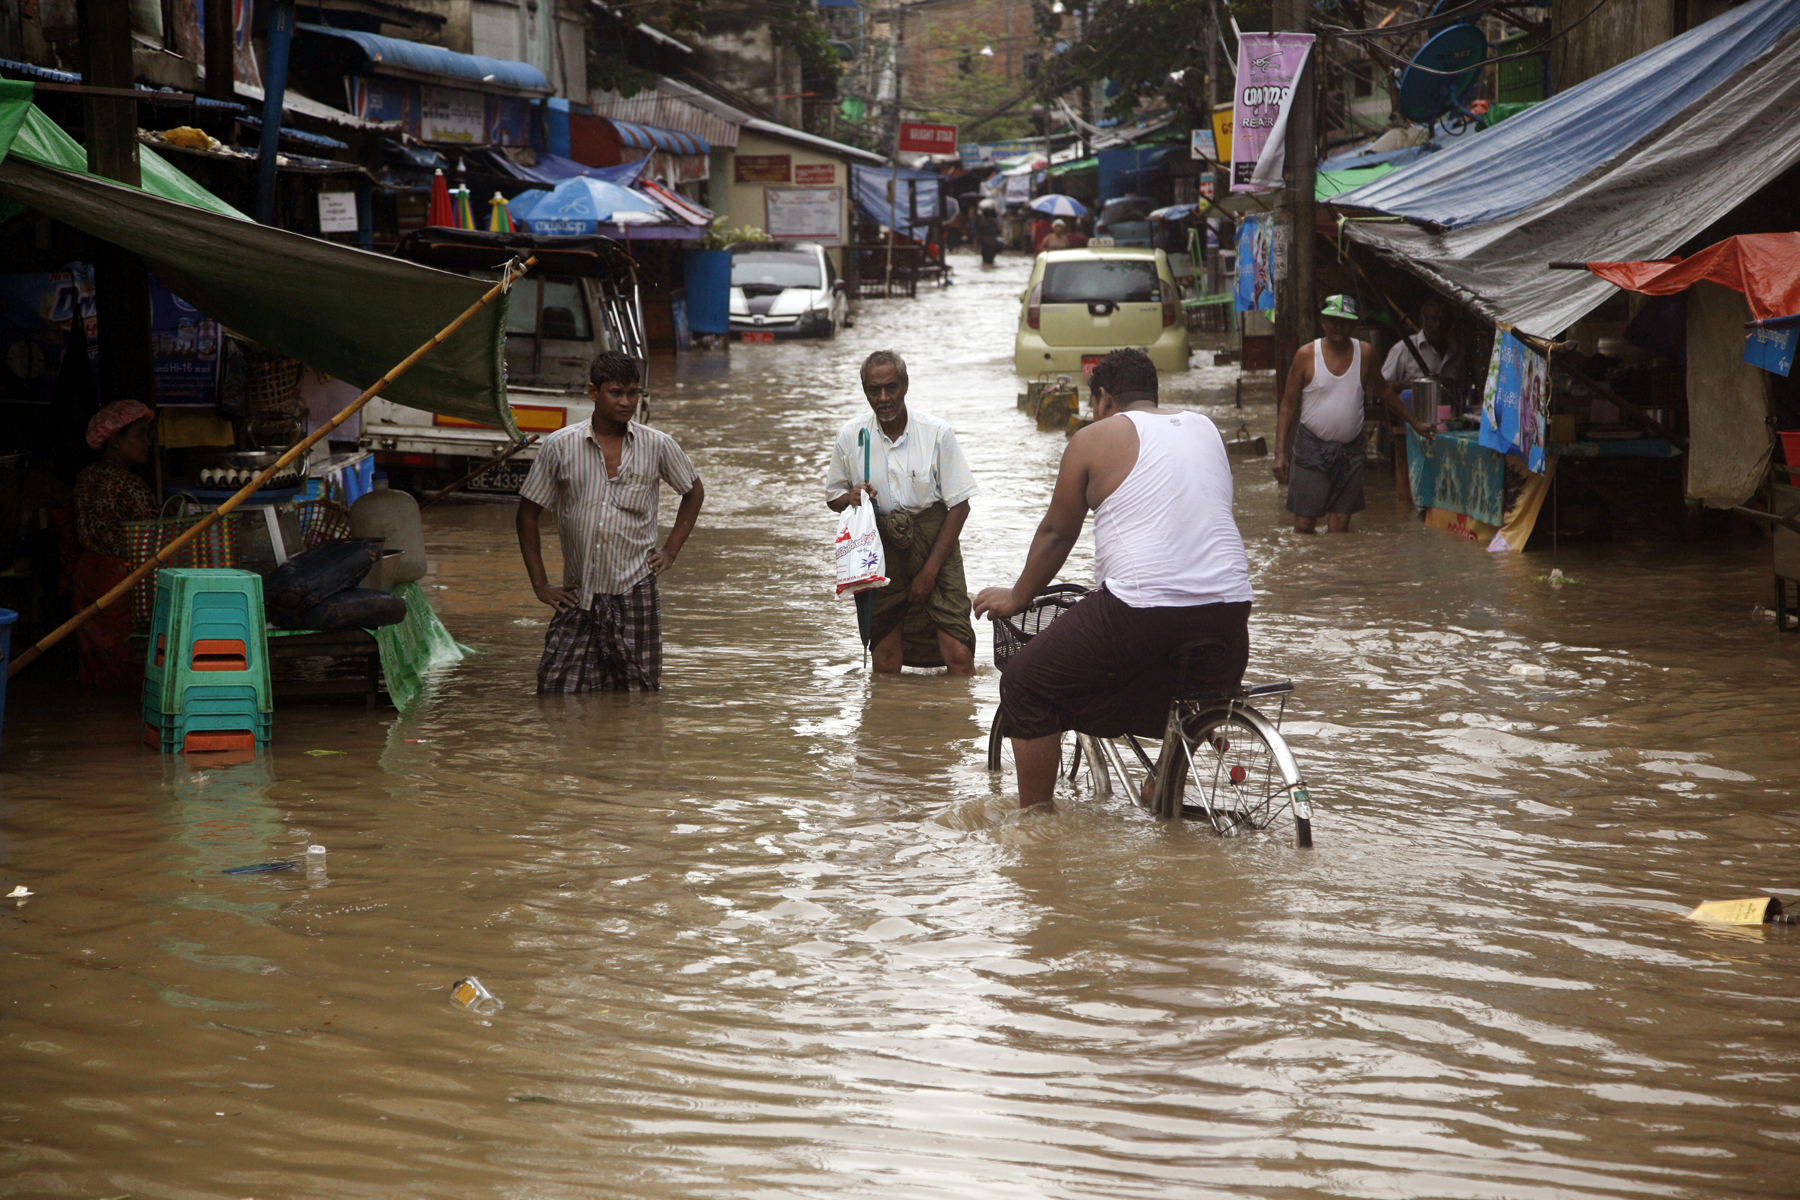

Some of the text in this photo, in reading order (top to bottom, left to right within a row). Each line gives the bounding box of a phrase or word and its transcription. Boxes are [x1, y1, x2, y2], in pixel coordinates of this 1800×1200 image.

[1453, 48, 1472, 60] NET
[910, 127, 954, 143] BRIGHT STAR
[1091, 239, 1113, 247] TAXI
[169, 362, 193, 373] Hi-16
